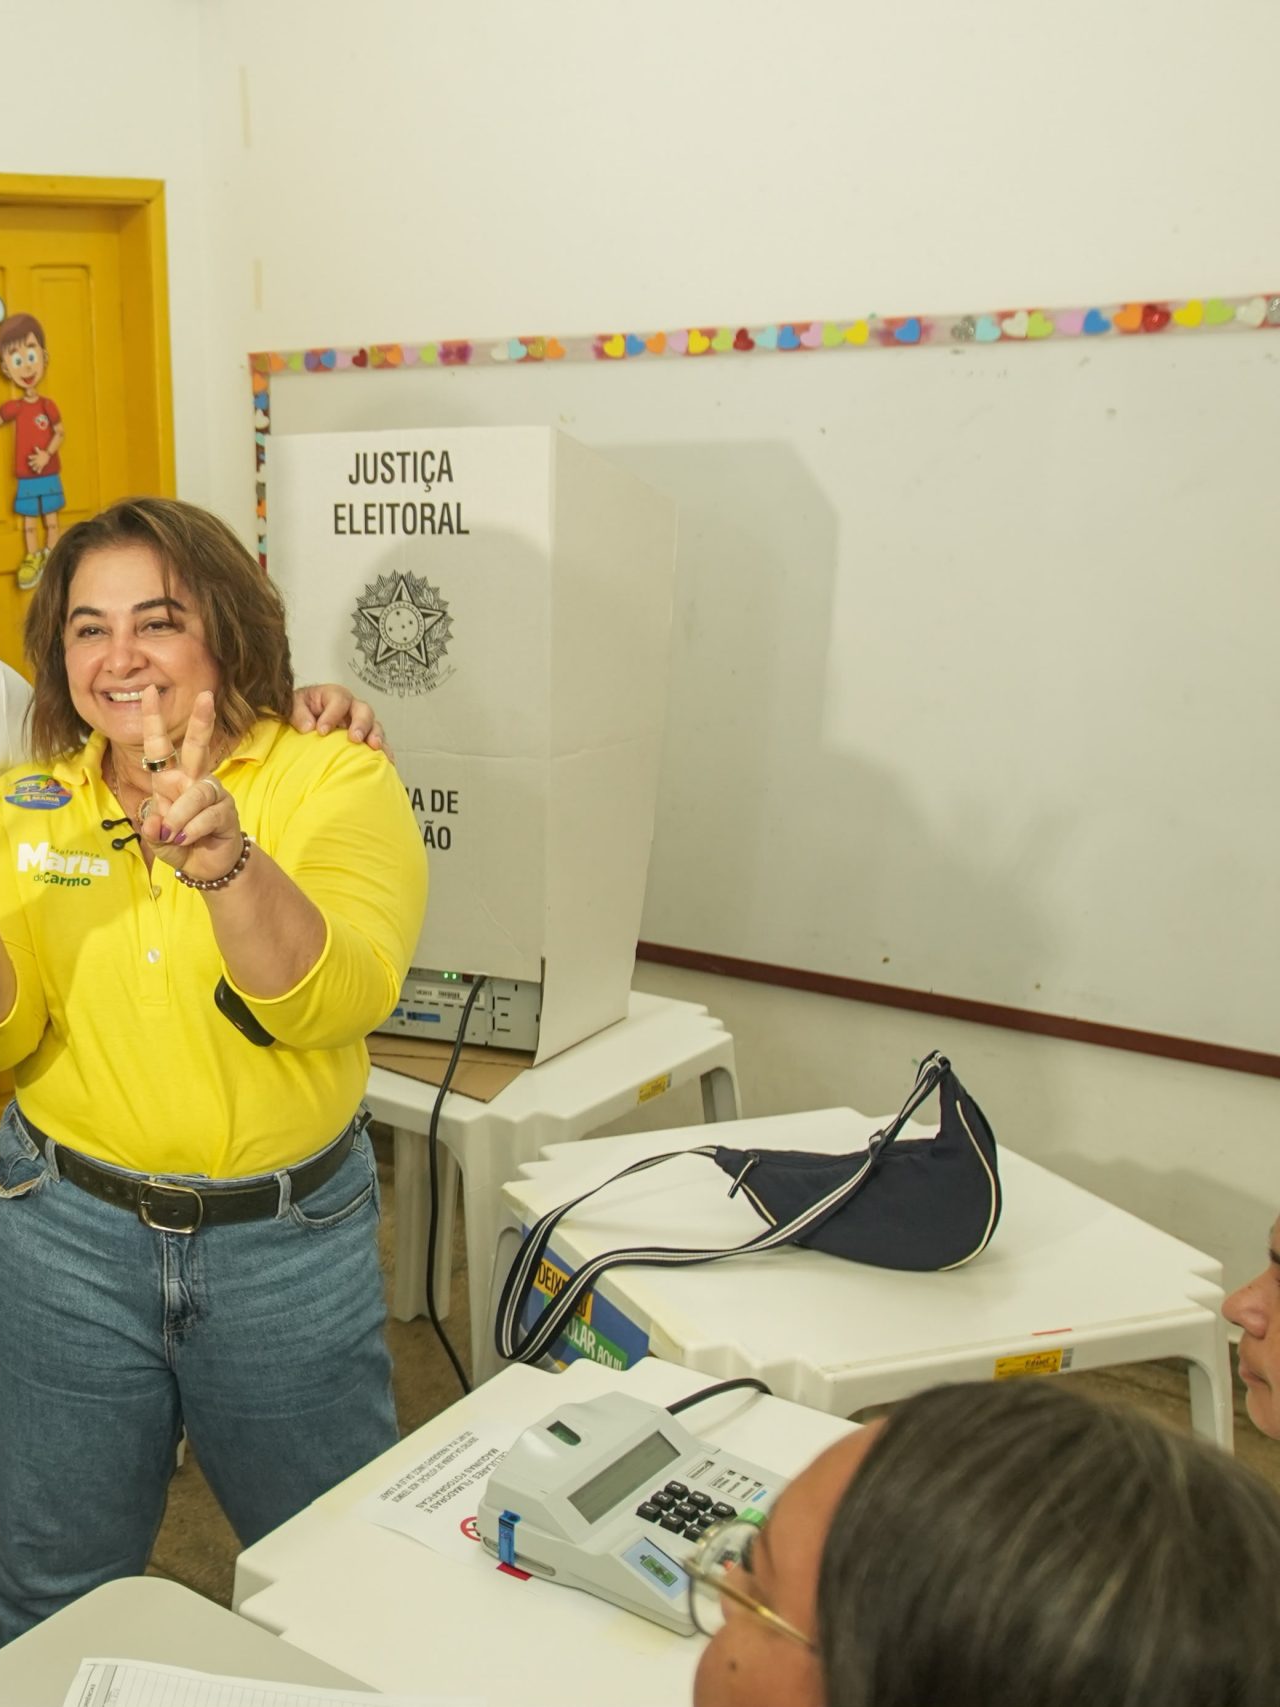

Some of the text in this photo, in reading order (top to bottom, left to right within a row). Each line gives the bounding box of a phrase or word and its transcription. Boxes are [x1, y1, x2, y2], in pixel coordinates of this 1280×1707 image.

[348, 450, 454, 492] JUSTIÇA
[334, 502, 470, 535] ELEITORAL
[431, 789, 459, 814] DE
[17, 842, 110, 877] Maria
[44, 872, 91, 887] Carmo
